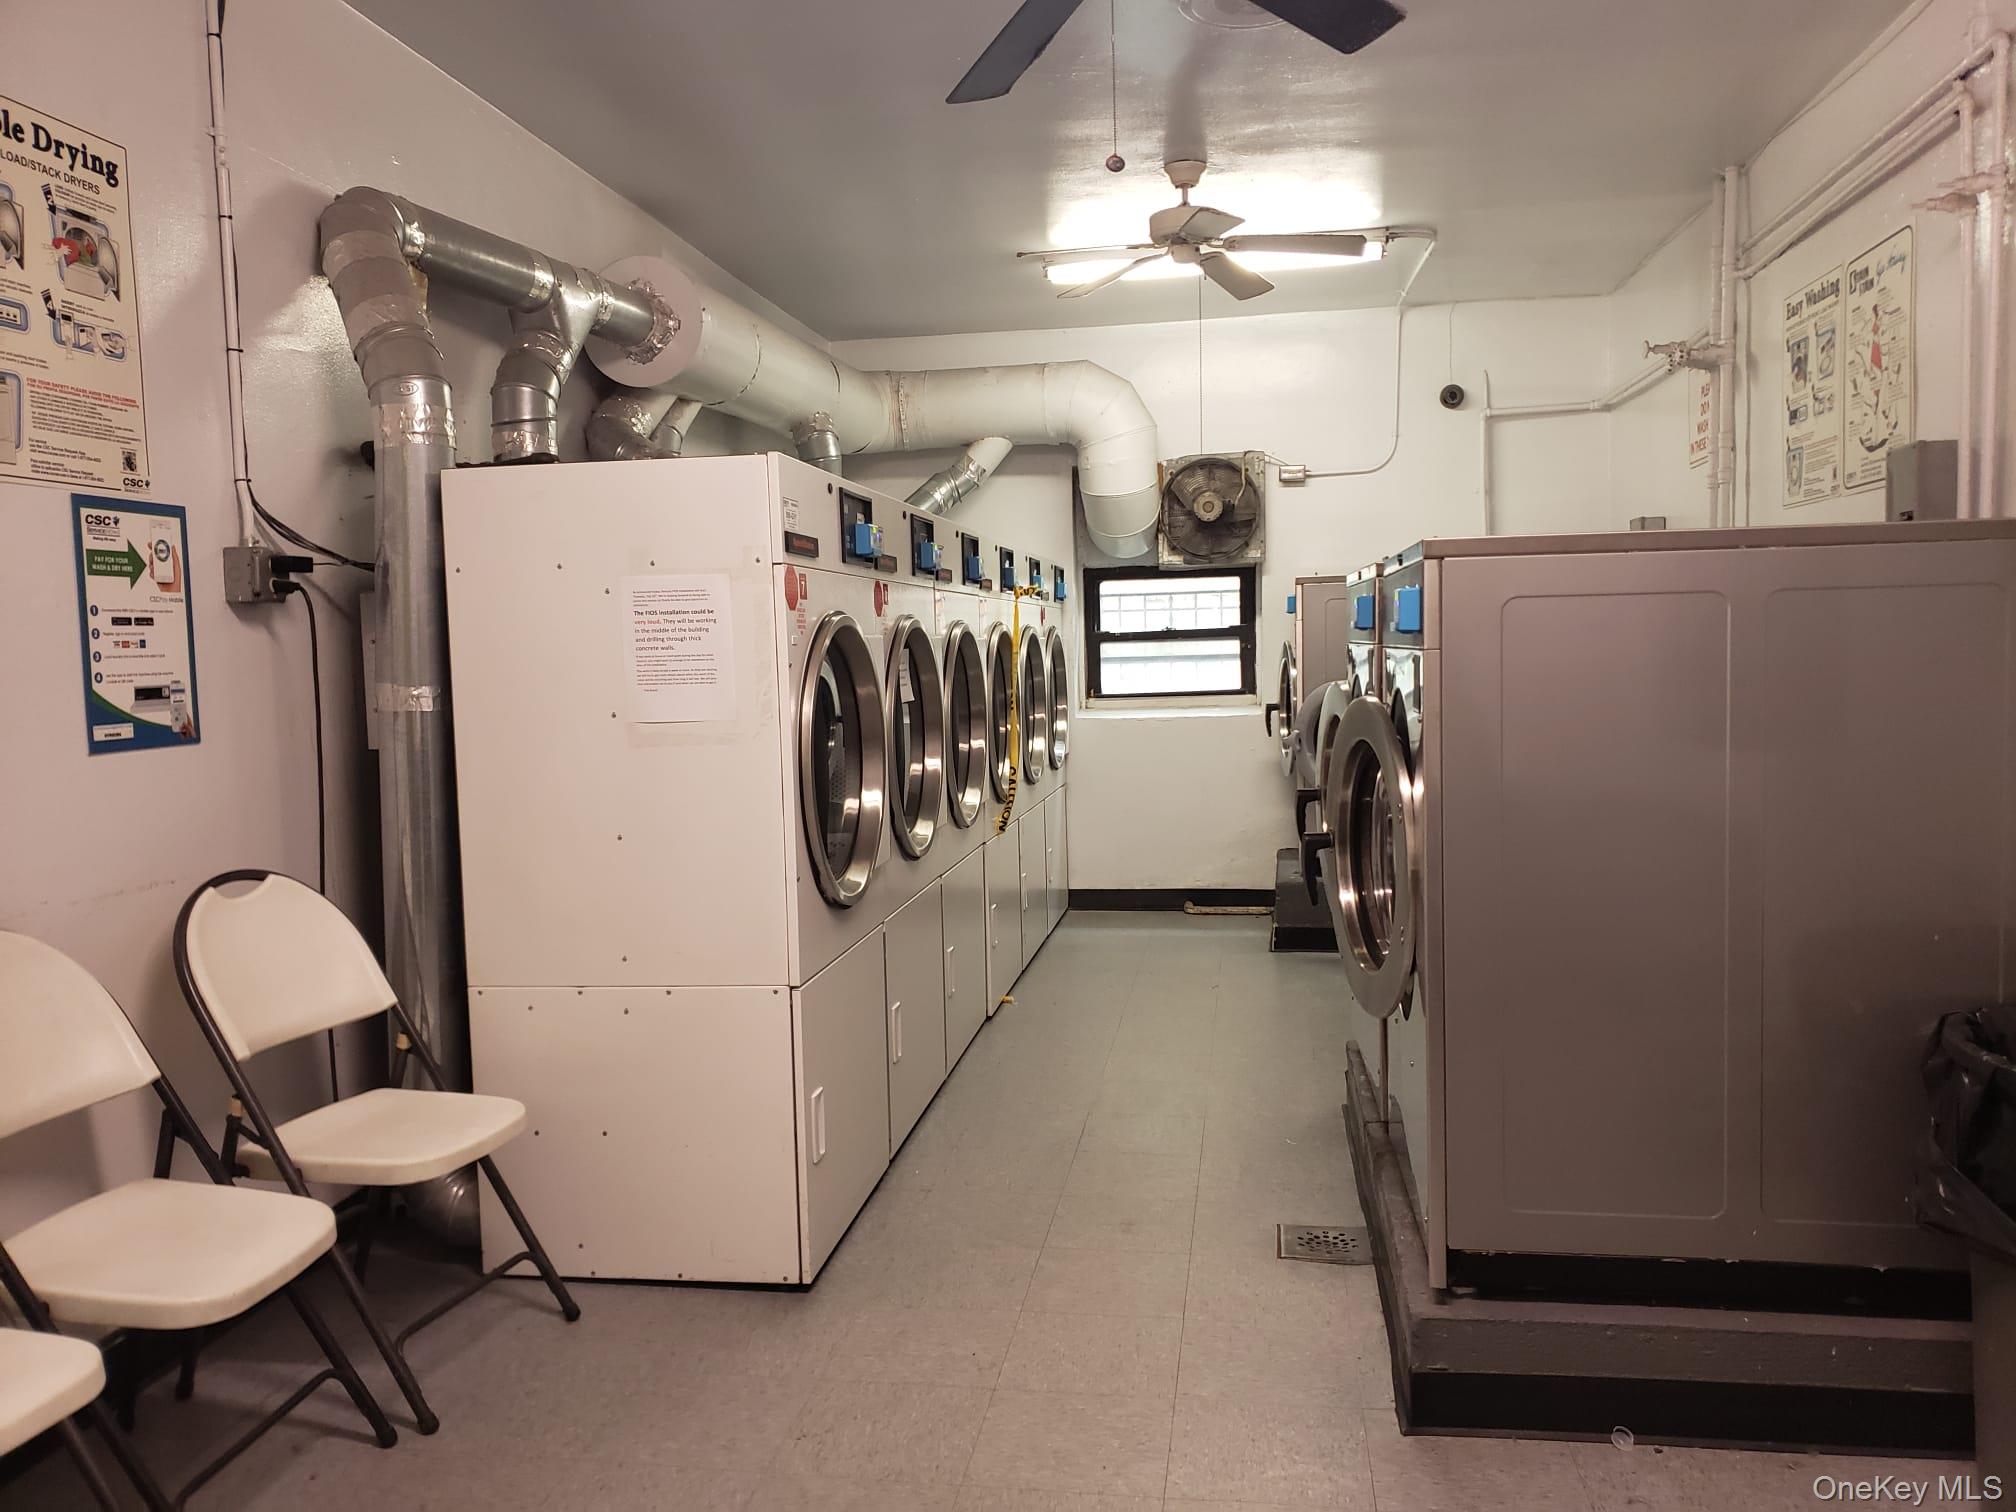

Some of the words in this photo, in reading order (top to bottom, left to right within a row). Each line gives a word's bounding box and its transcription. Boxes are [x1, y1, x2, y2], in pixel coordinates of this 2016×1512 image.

[31, 121, 119, 188] Drying
[63, 173, 101, 195] DRYERS
[1786, 300, 1803, 320] Easy
[1805, 278, 1840, 308] Washing
[122, 477, 144, 488] CSC
[85, 514, 112, 526] CSC
[800, 580, 806, 596] 7
[998, 766, 1016, 832] CAUTION
